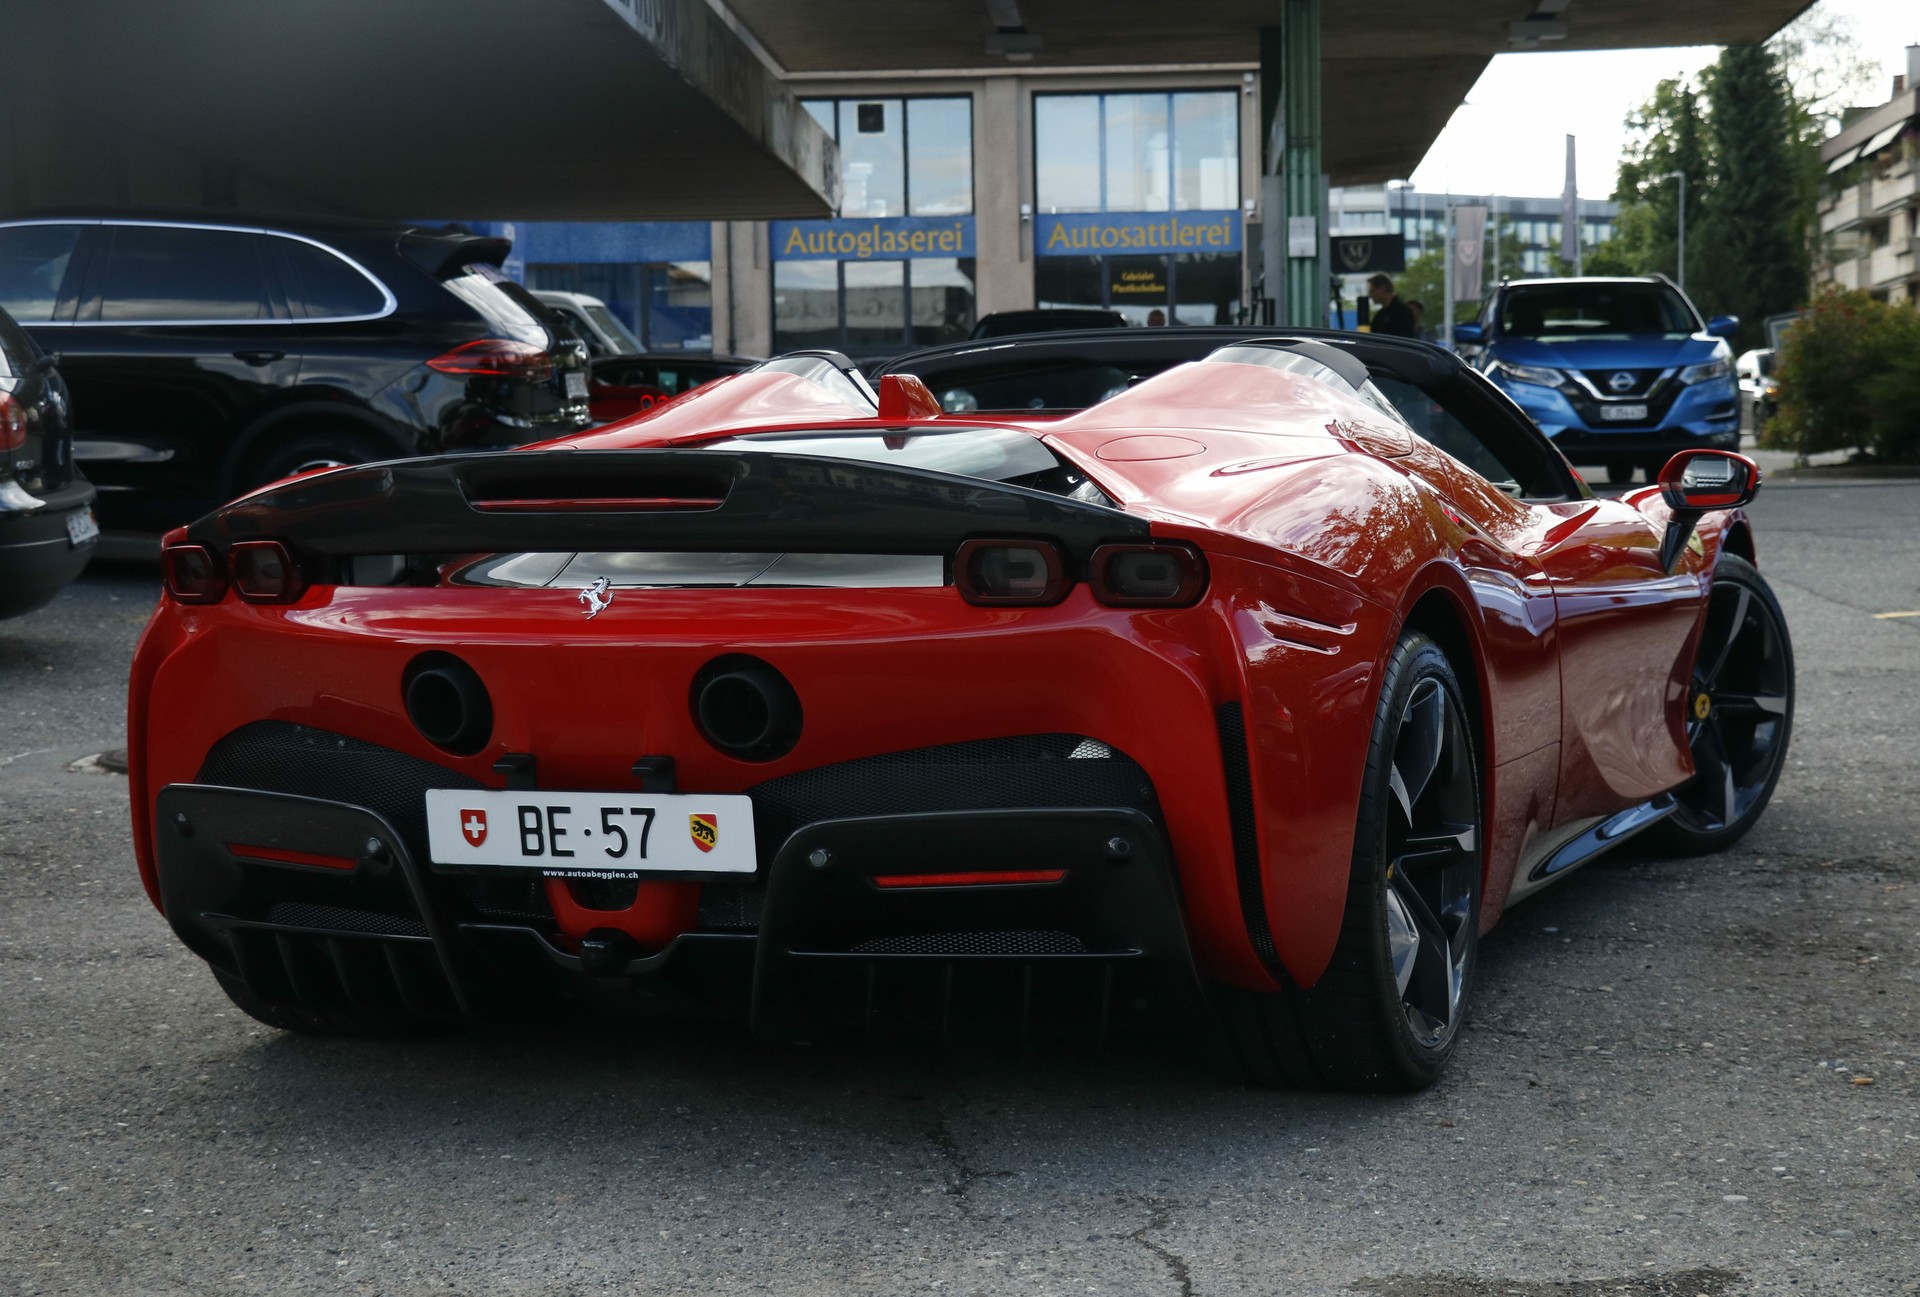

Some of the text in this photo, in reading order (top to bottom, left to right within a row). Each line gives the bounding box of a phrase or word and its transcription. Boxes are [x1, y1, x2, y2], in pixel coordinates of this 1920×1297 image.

[784, 223, 963, 257] Autoglaserei
[1047, 217, 1231, 248] Autosattlerei
[542, 869, 639, 880] www.autoabegglen.ch
